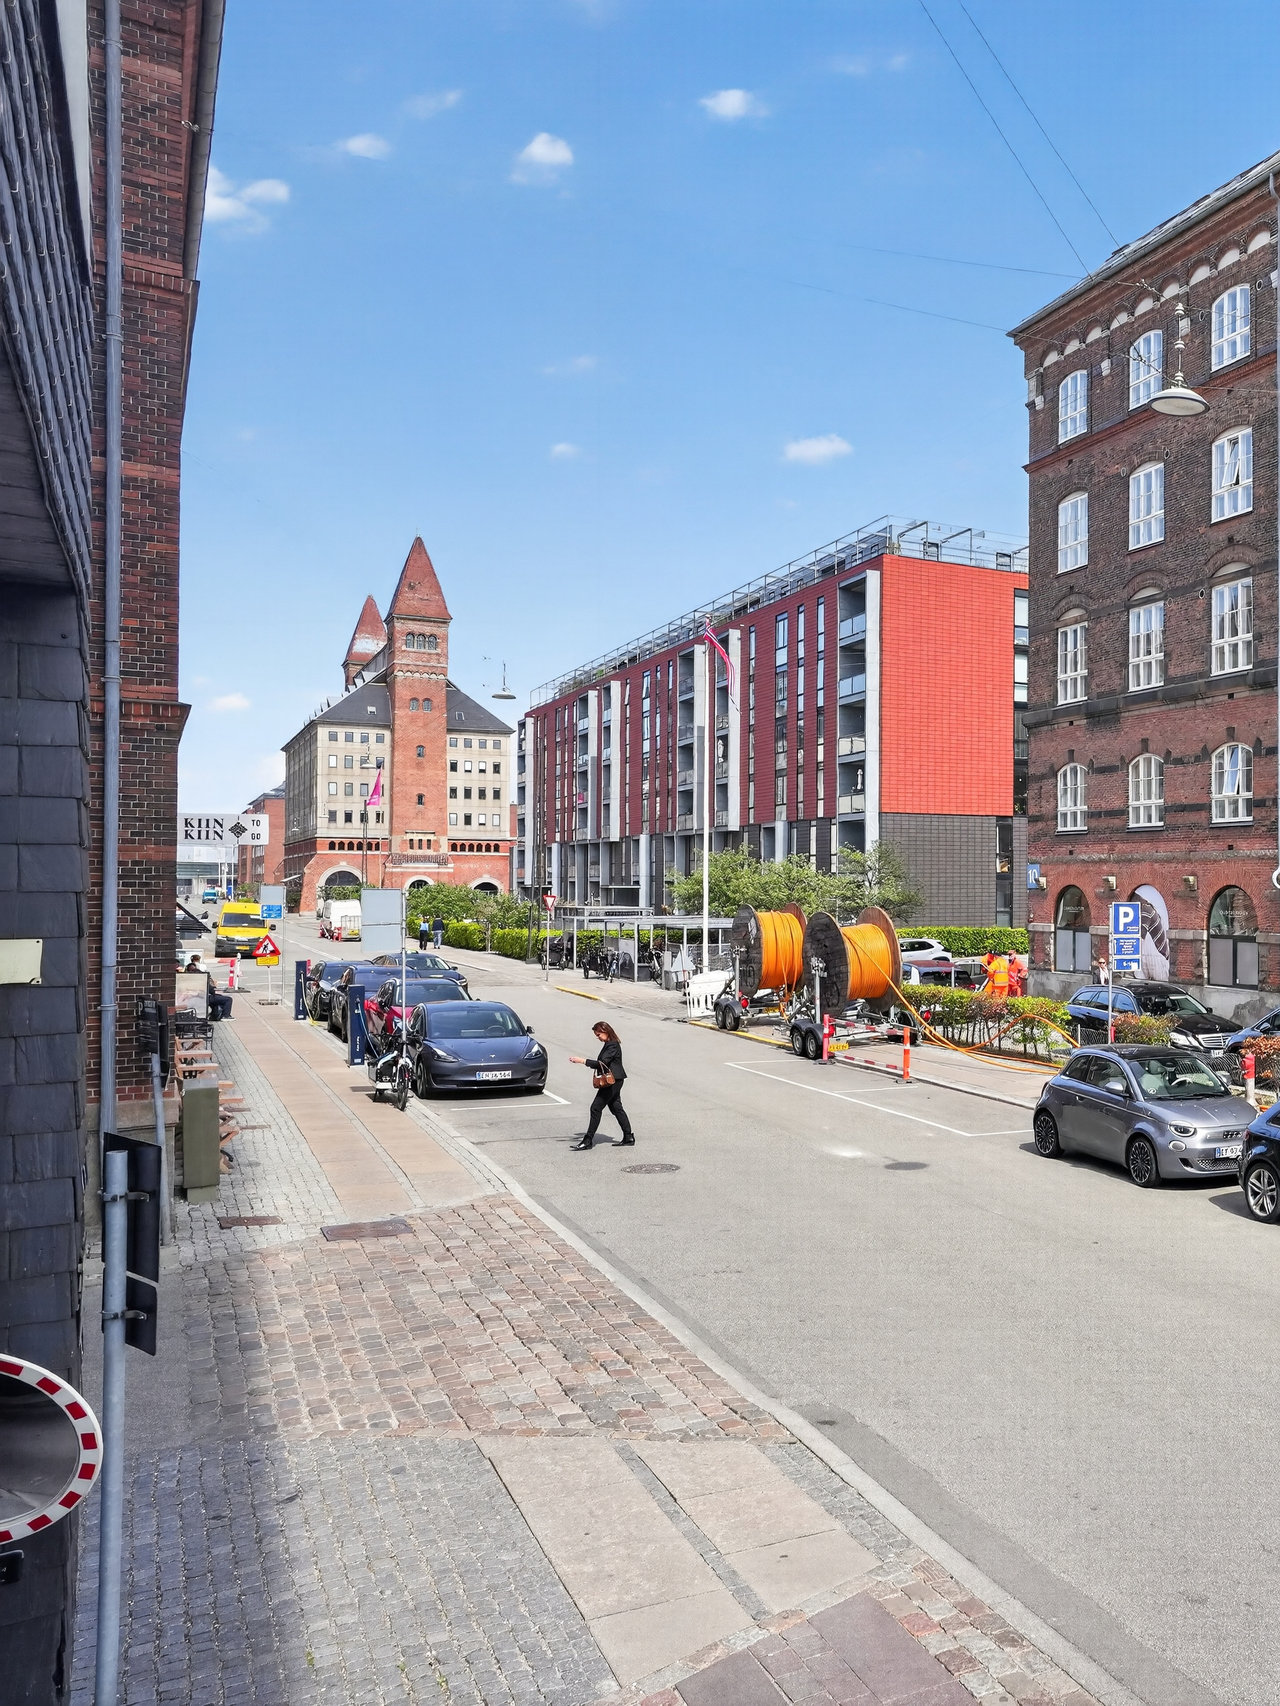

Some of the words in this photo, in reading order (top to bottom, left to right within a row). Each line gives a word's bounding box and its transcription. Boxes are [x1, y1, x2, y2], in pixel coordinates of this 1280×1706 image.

[184, 818, 223, 829] KIIN
[251, 819, 261, 827] TO
[184, 829, 223, 841] KIIN
[251, 833, 261, 841] GO
[1028, 869, 1038, 884] 10
[1119, 906, 1134, 932] P
